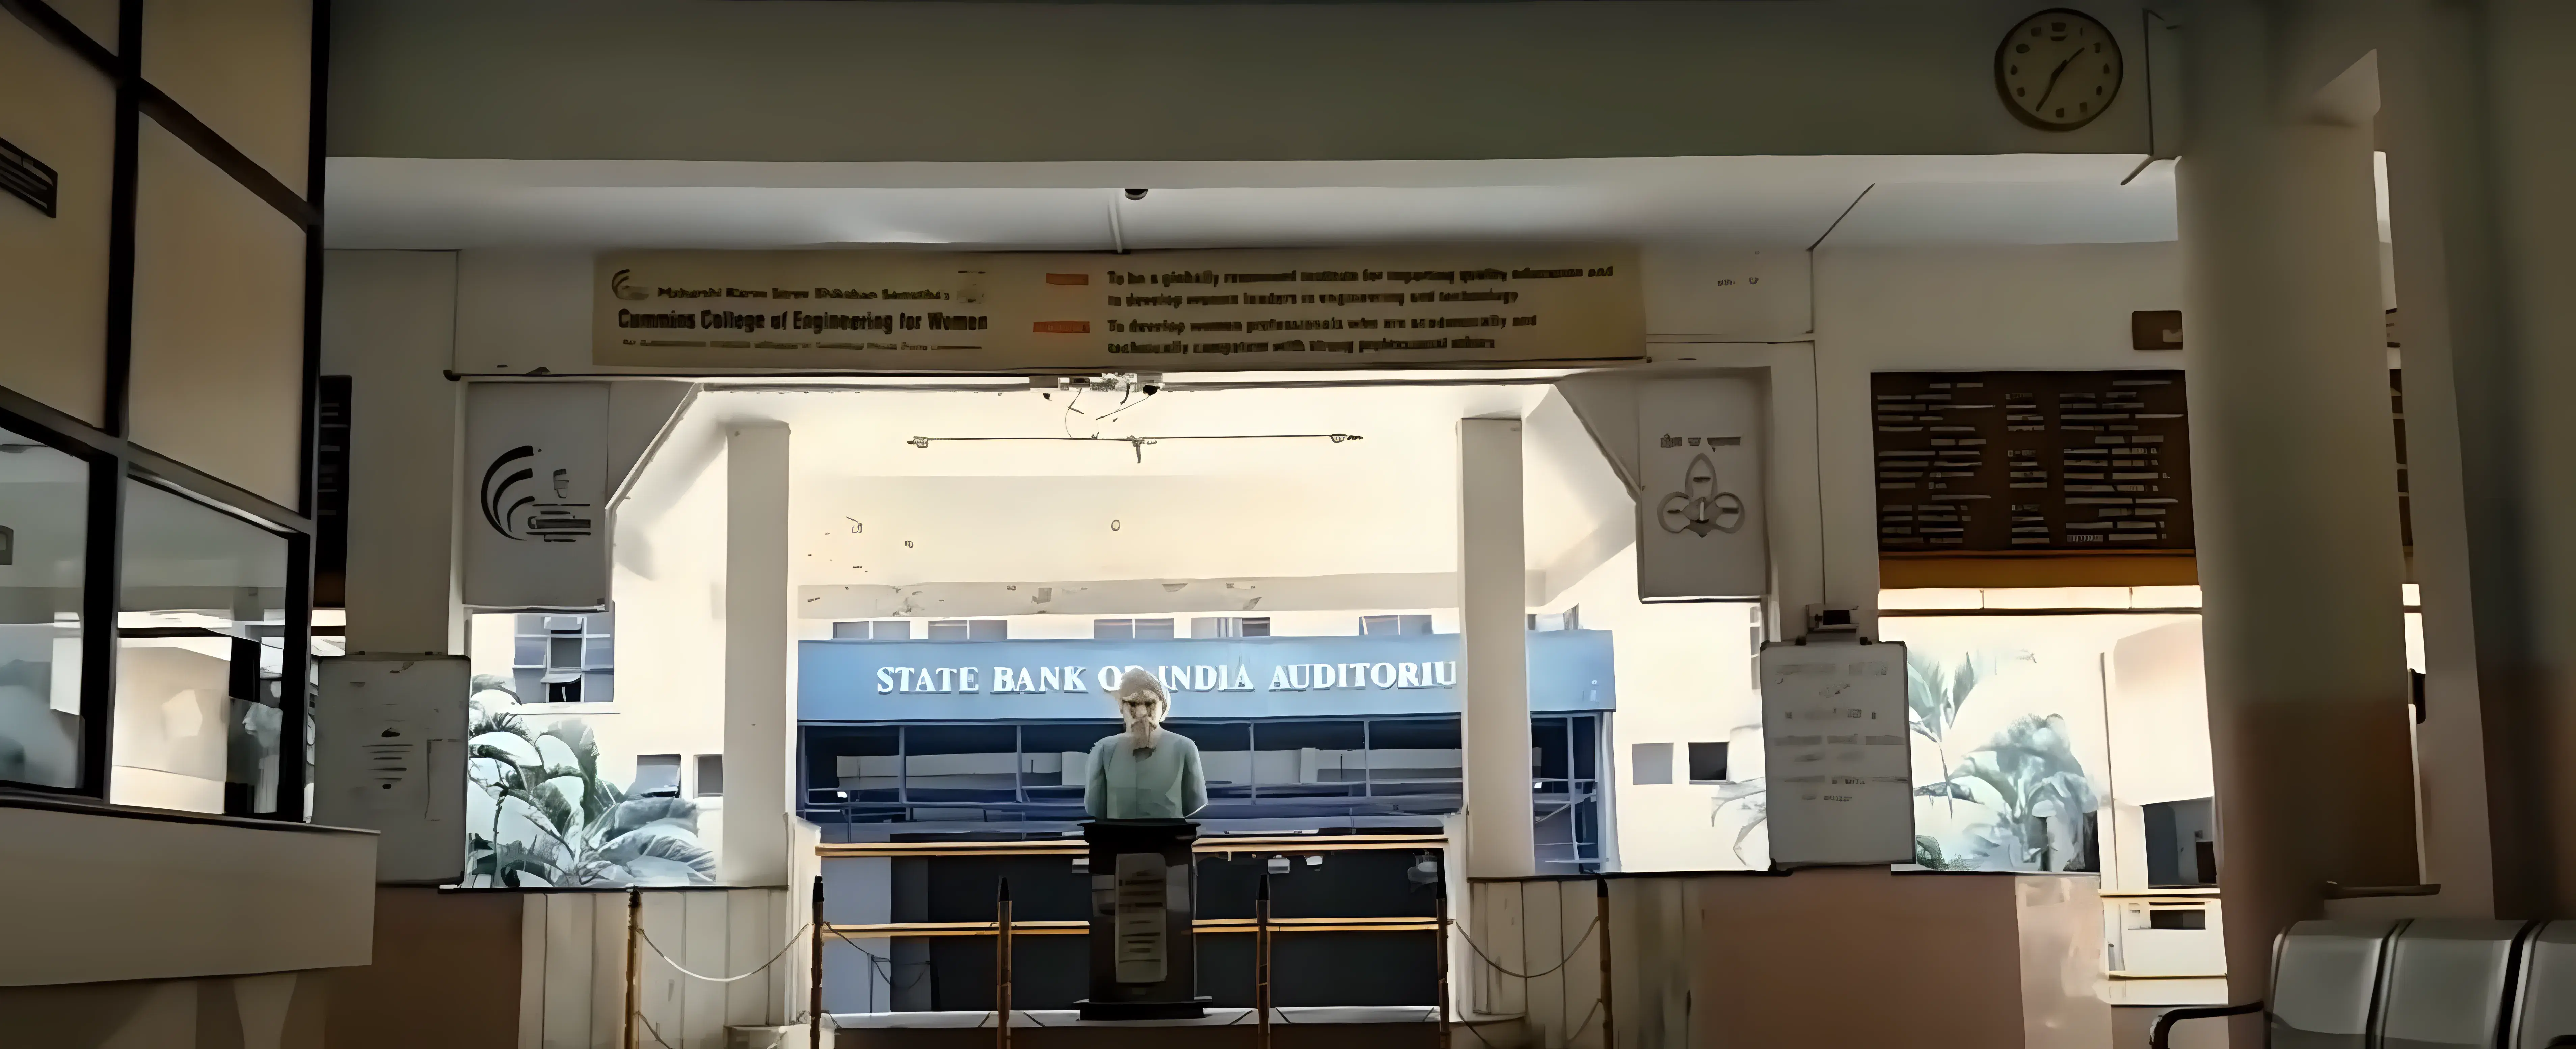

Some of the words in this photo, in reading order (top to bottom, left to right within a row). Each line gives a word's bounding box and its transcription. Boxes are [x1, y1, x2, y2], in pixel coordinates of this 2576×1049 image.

[618, 308, 695, 328] Cummins
[701, 309, 765, 332] College
[771, 310, 787, 329] of
[794, 310, 892, 334] Engineering
[900, 311, 921, 329] for
[928, 312, 987, 330] Women
[877, 667, 979, 694] STATE
[990, 666, 1089, 693] BANK
[1158, 664, 1255, 692] INDIA
[1268, 661, 1456, 692] AUDITORIU
